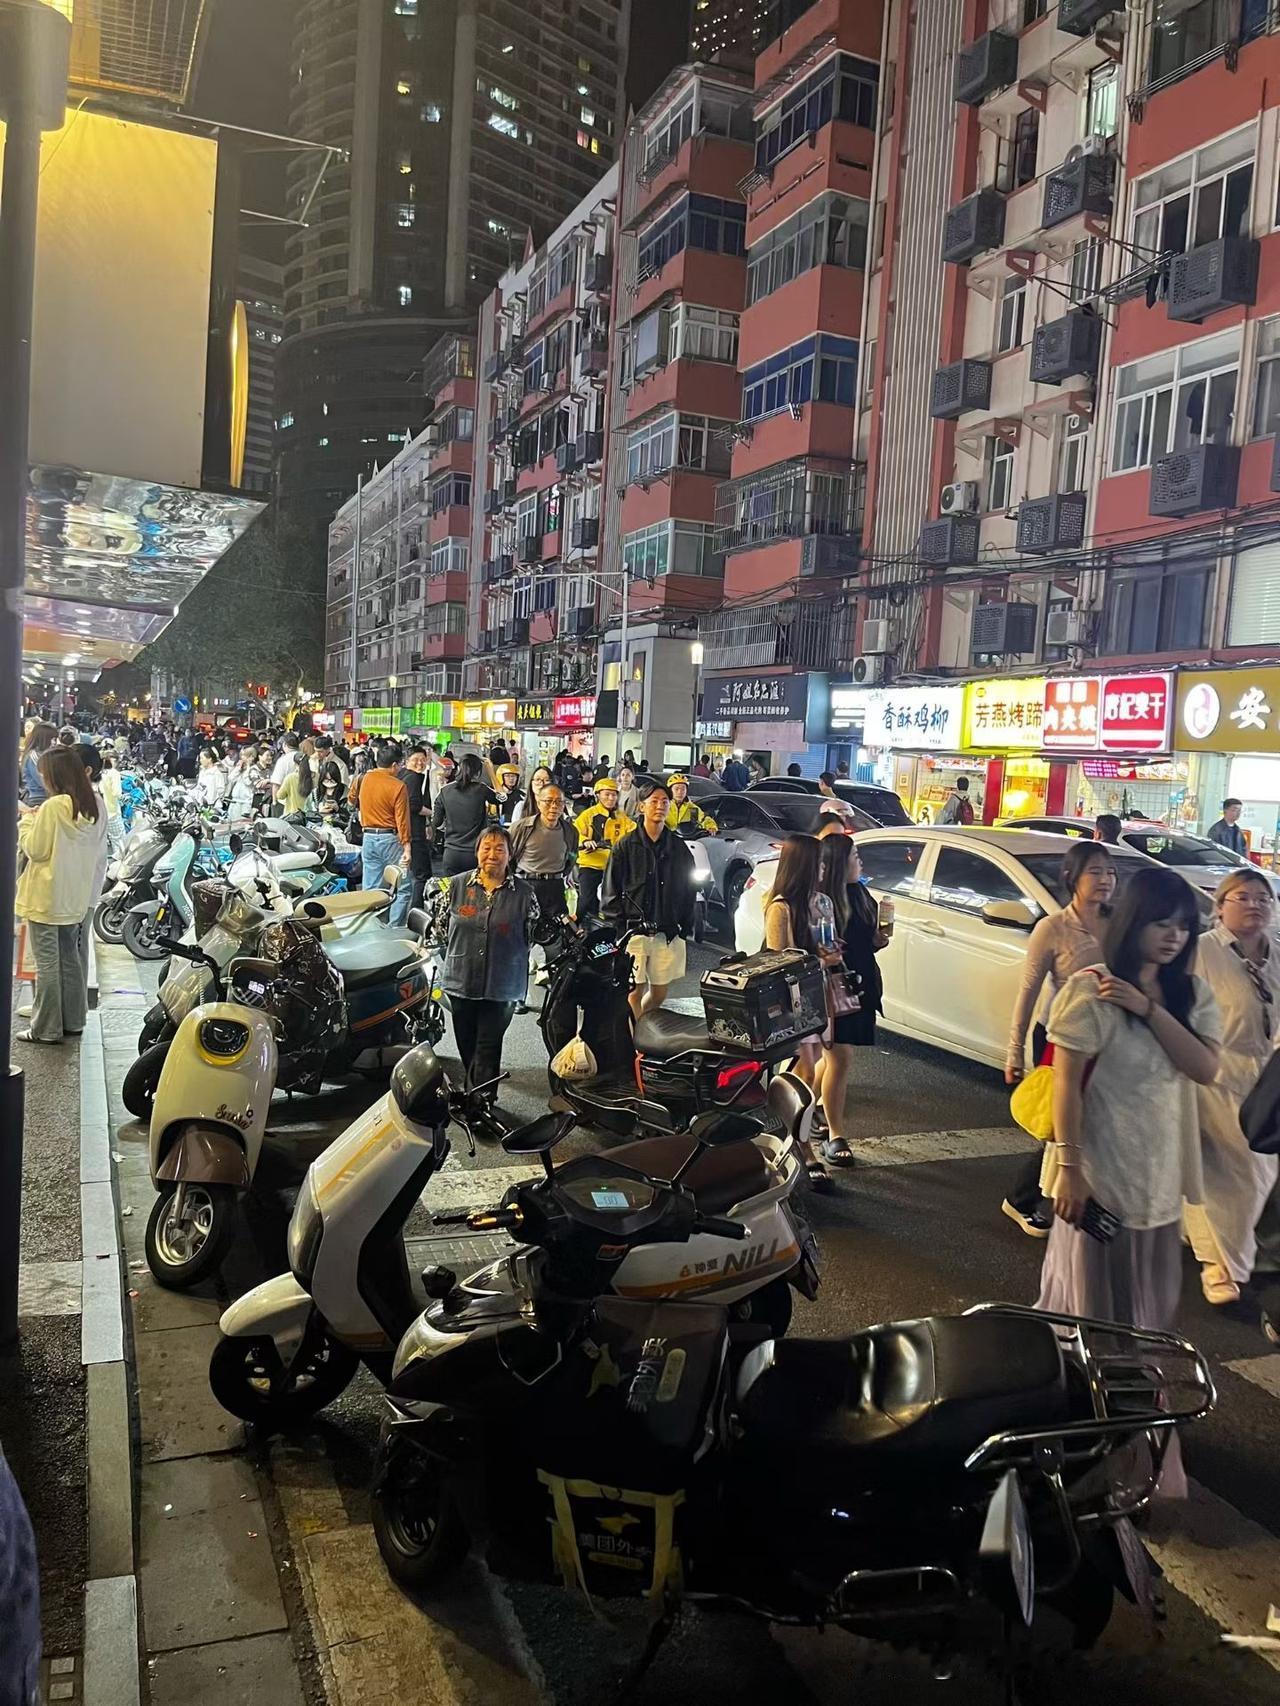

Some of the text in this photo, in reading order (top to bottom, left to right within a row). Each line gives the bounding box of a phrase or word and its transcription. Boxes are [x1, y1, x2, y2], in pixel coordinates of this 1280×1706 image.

[882, 701, 949, 734] 香酥鸡柳
[975, 701, 1044, 729] 芳燕烤蹄
[1230, 687, 1271, 730] 安
[579, 1533, 652, 1559] 团外
